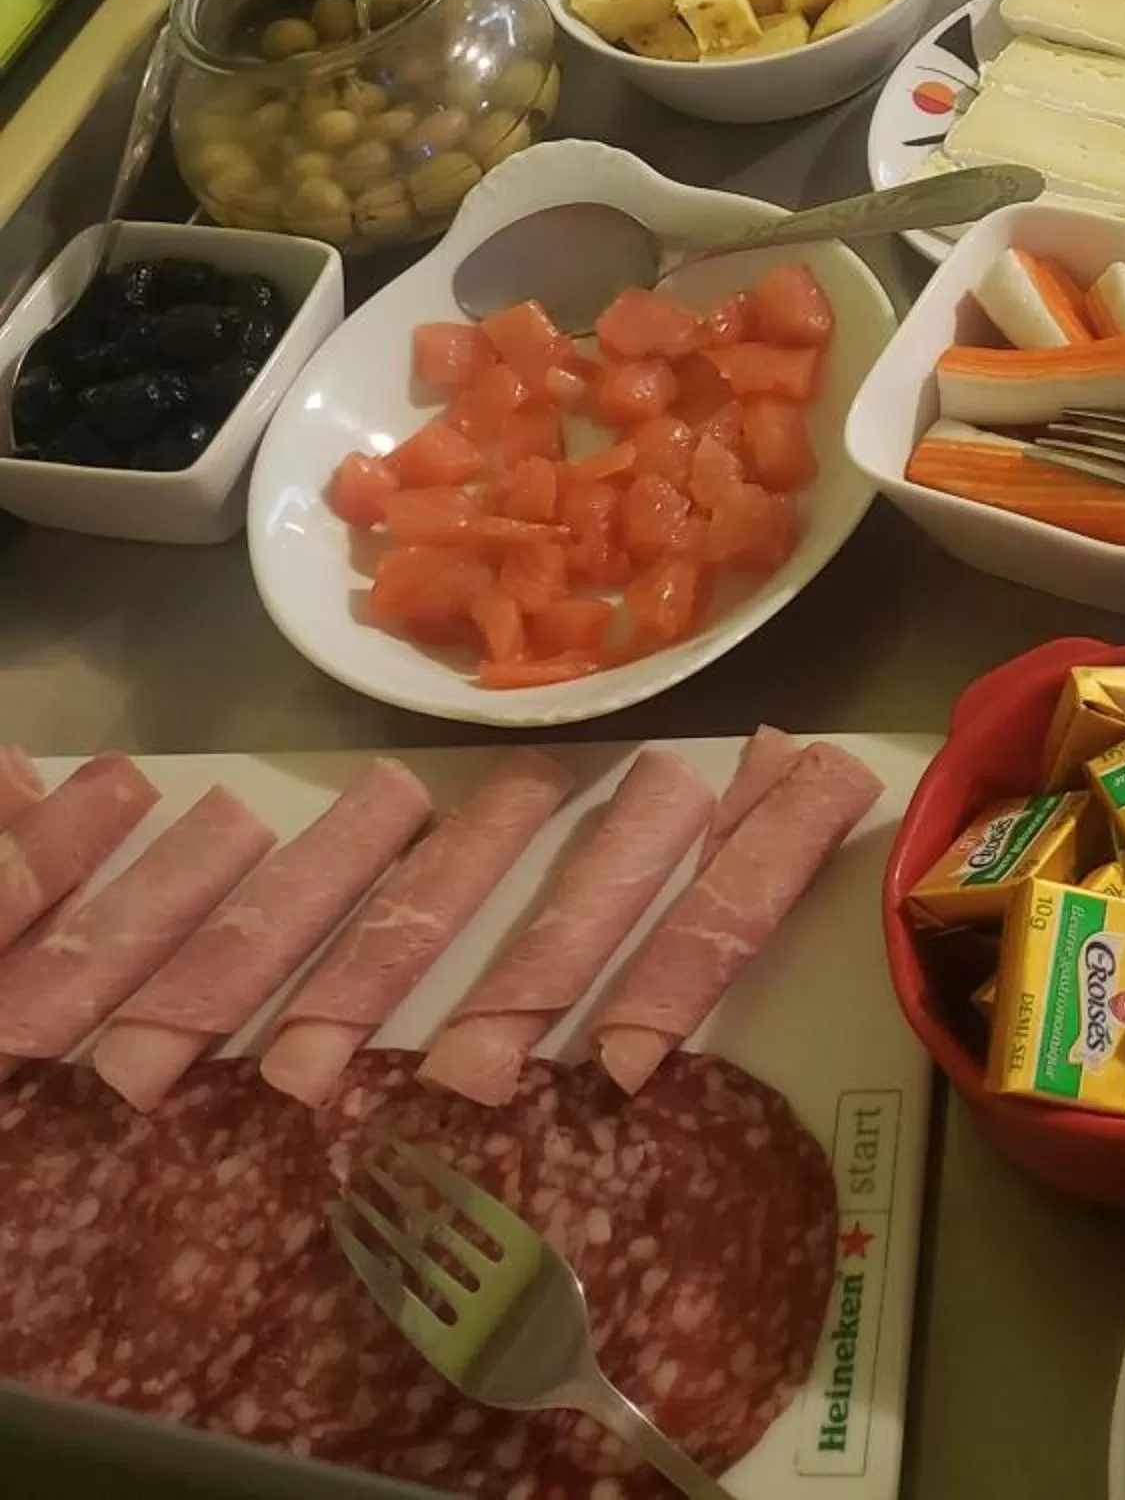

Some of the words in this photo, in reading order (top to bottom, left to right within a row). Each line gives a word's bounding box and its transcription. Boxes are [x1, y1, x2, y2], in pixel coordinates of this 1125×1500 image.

[1029, 896, 1054, 931] 10g
[1084, 940, 1117, 1053] Croisés
[850, 1105, 883, 1196] start
[817, 1271, 865, 1454] Heineken
